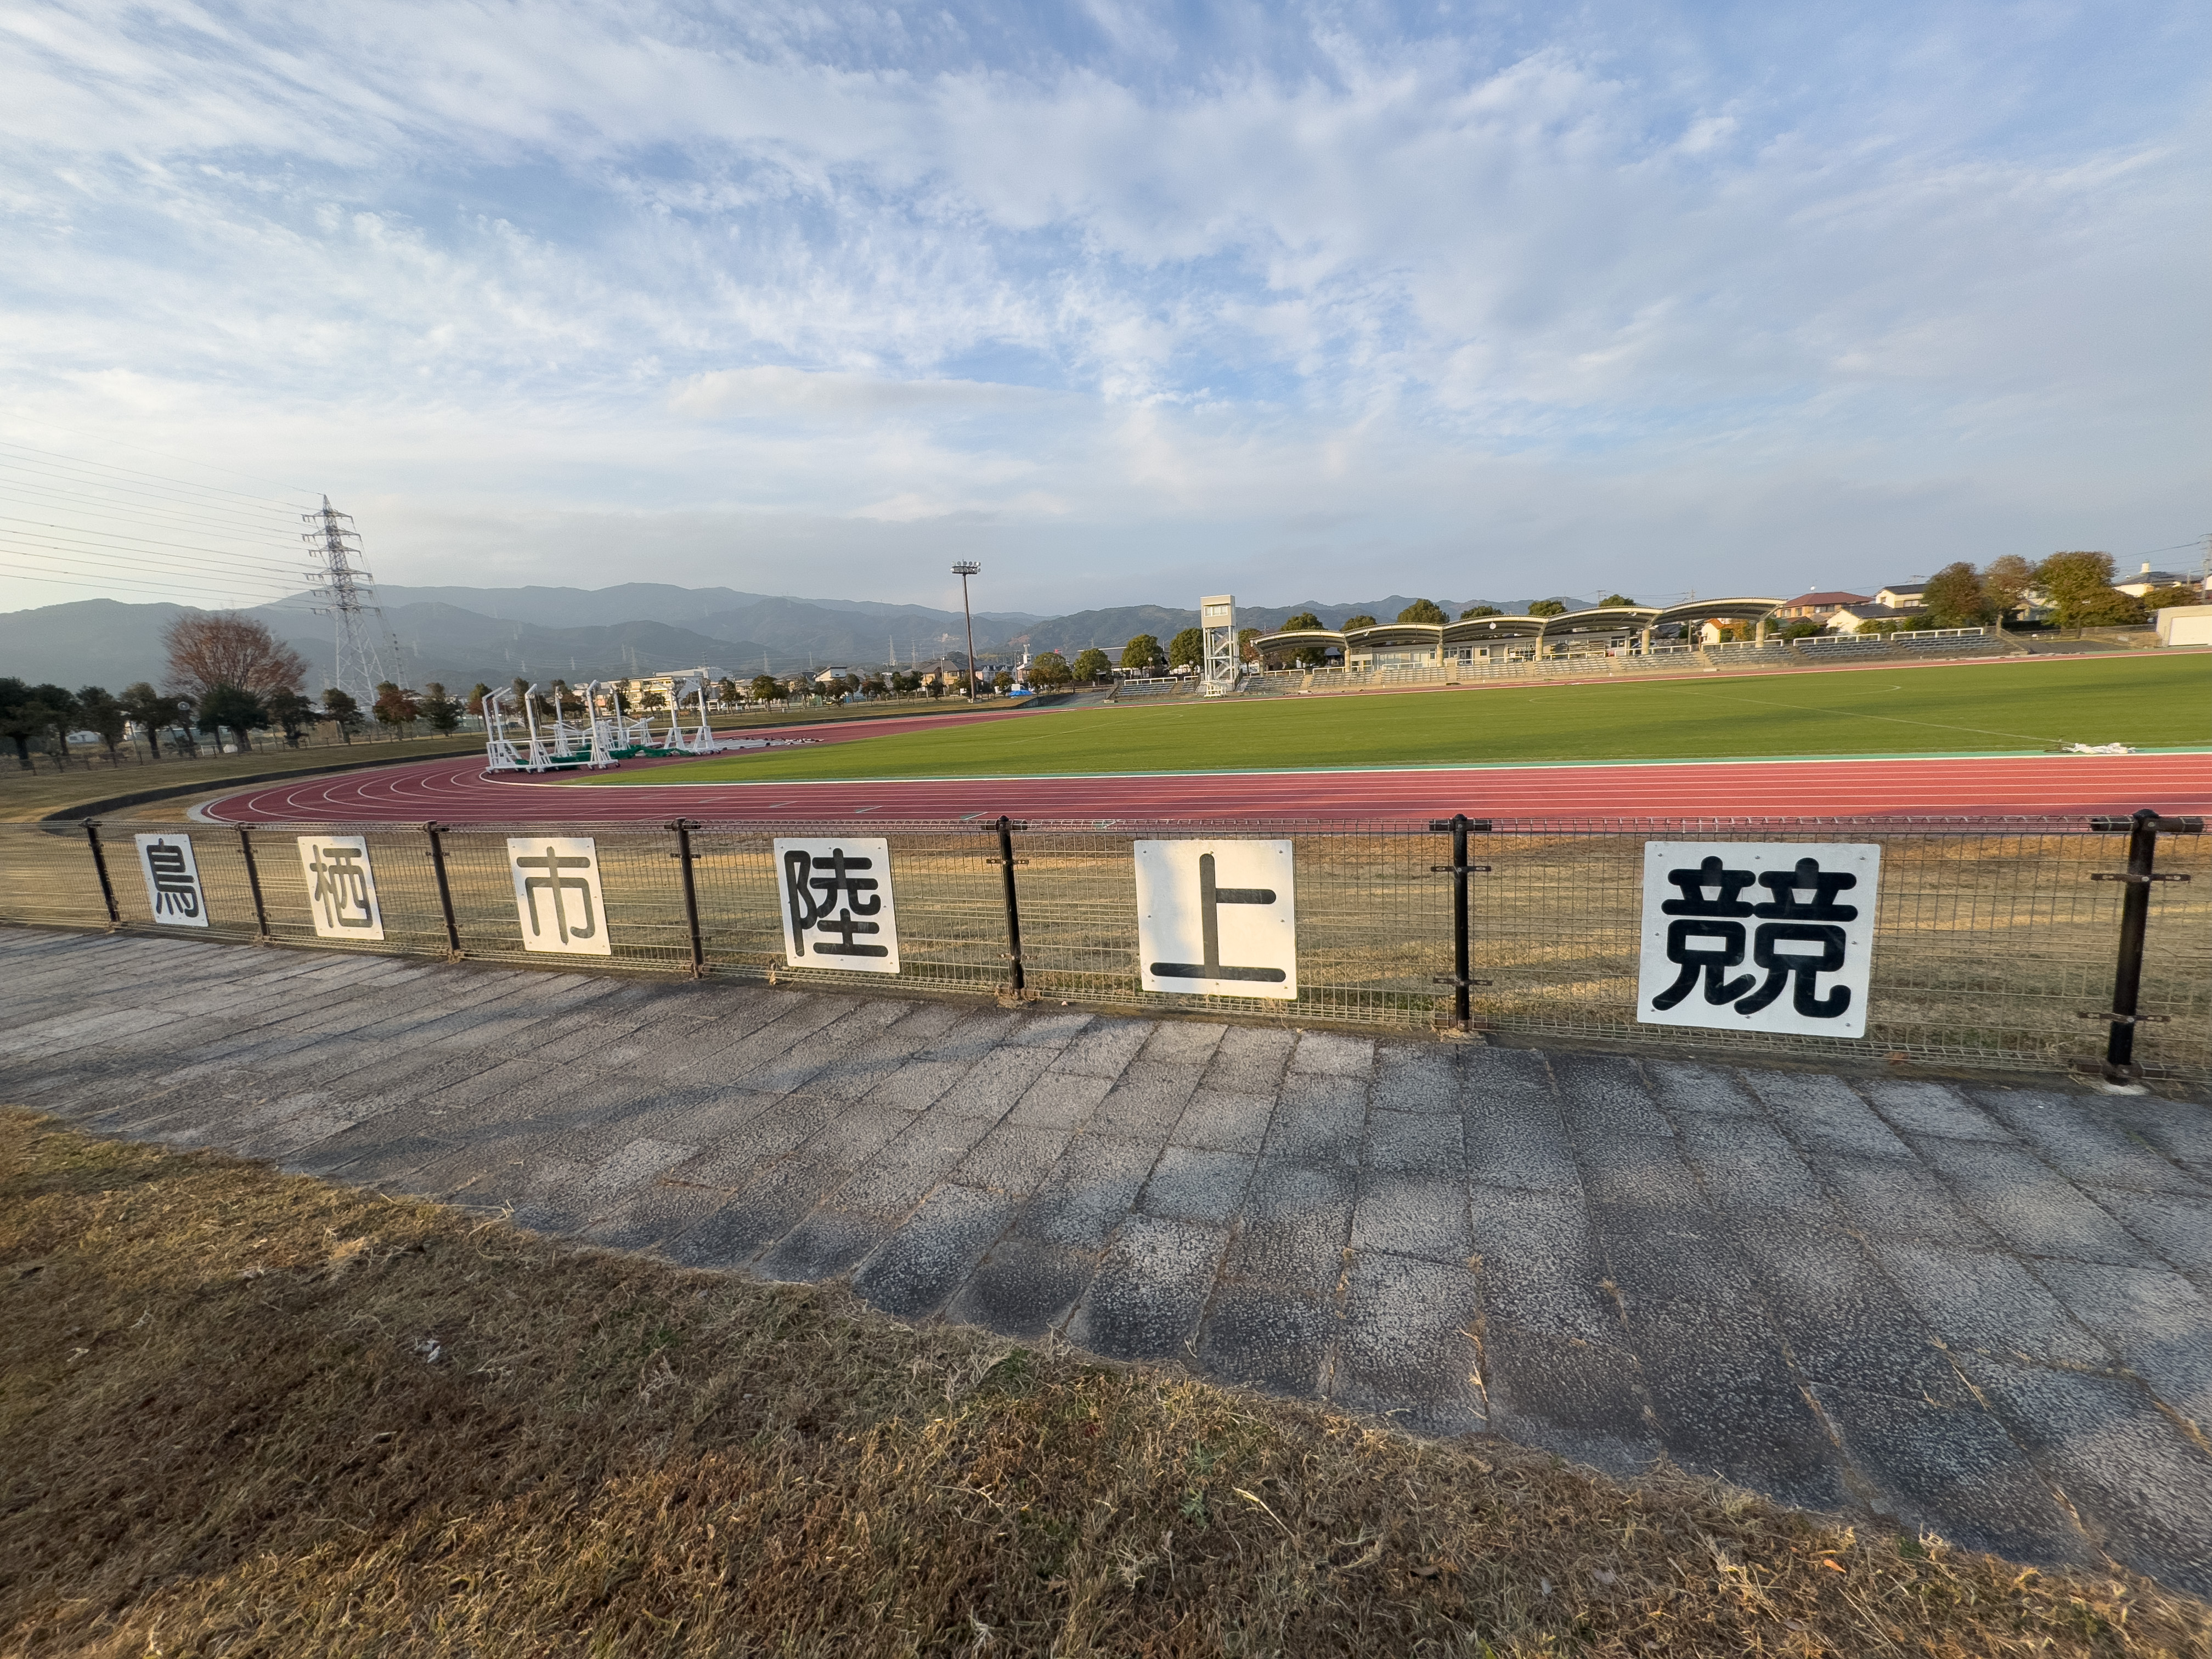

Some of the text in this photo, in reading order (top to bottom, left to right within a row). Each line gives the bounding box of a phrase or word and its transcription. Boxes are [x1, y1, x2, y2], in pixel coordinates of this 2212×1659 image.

[146, 838, 199, 917] 鳥
[309, 844, 373, 928] 栖
[516, 846, 595, 945] 市
[784, 848, 888, 957] 陸
[1150, 854, 1286, 982] 上
[1652, 856, 1858, 1018] 競
